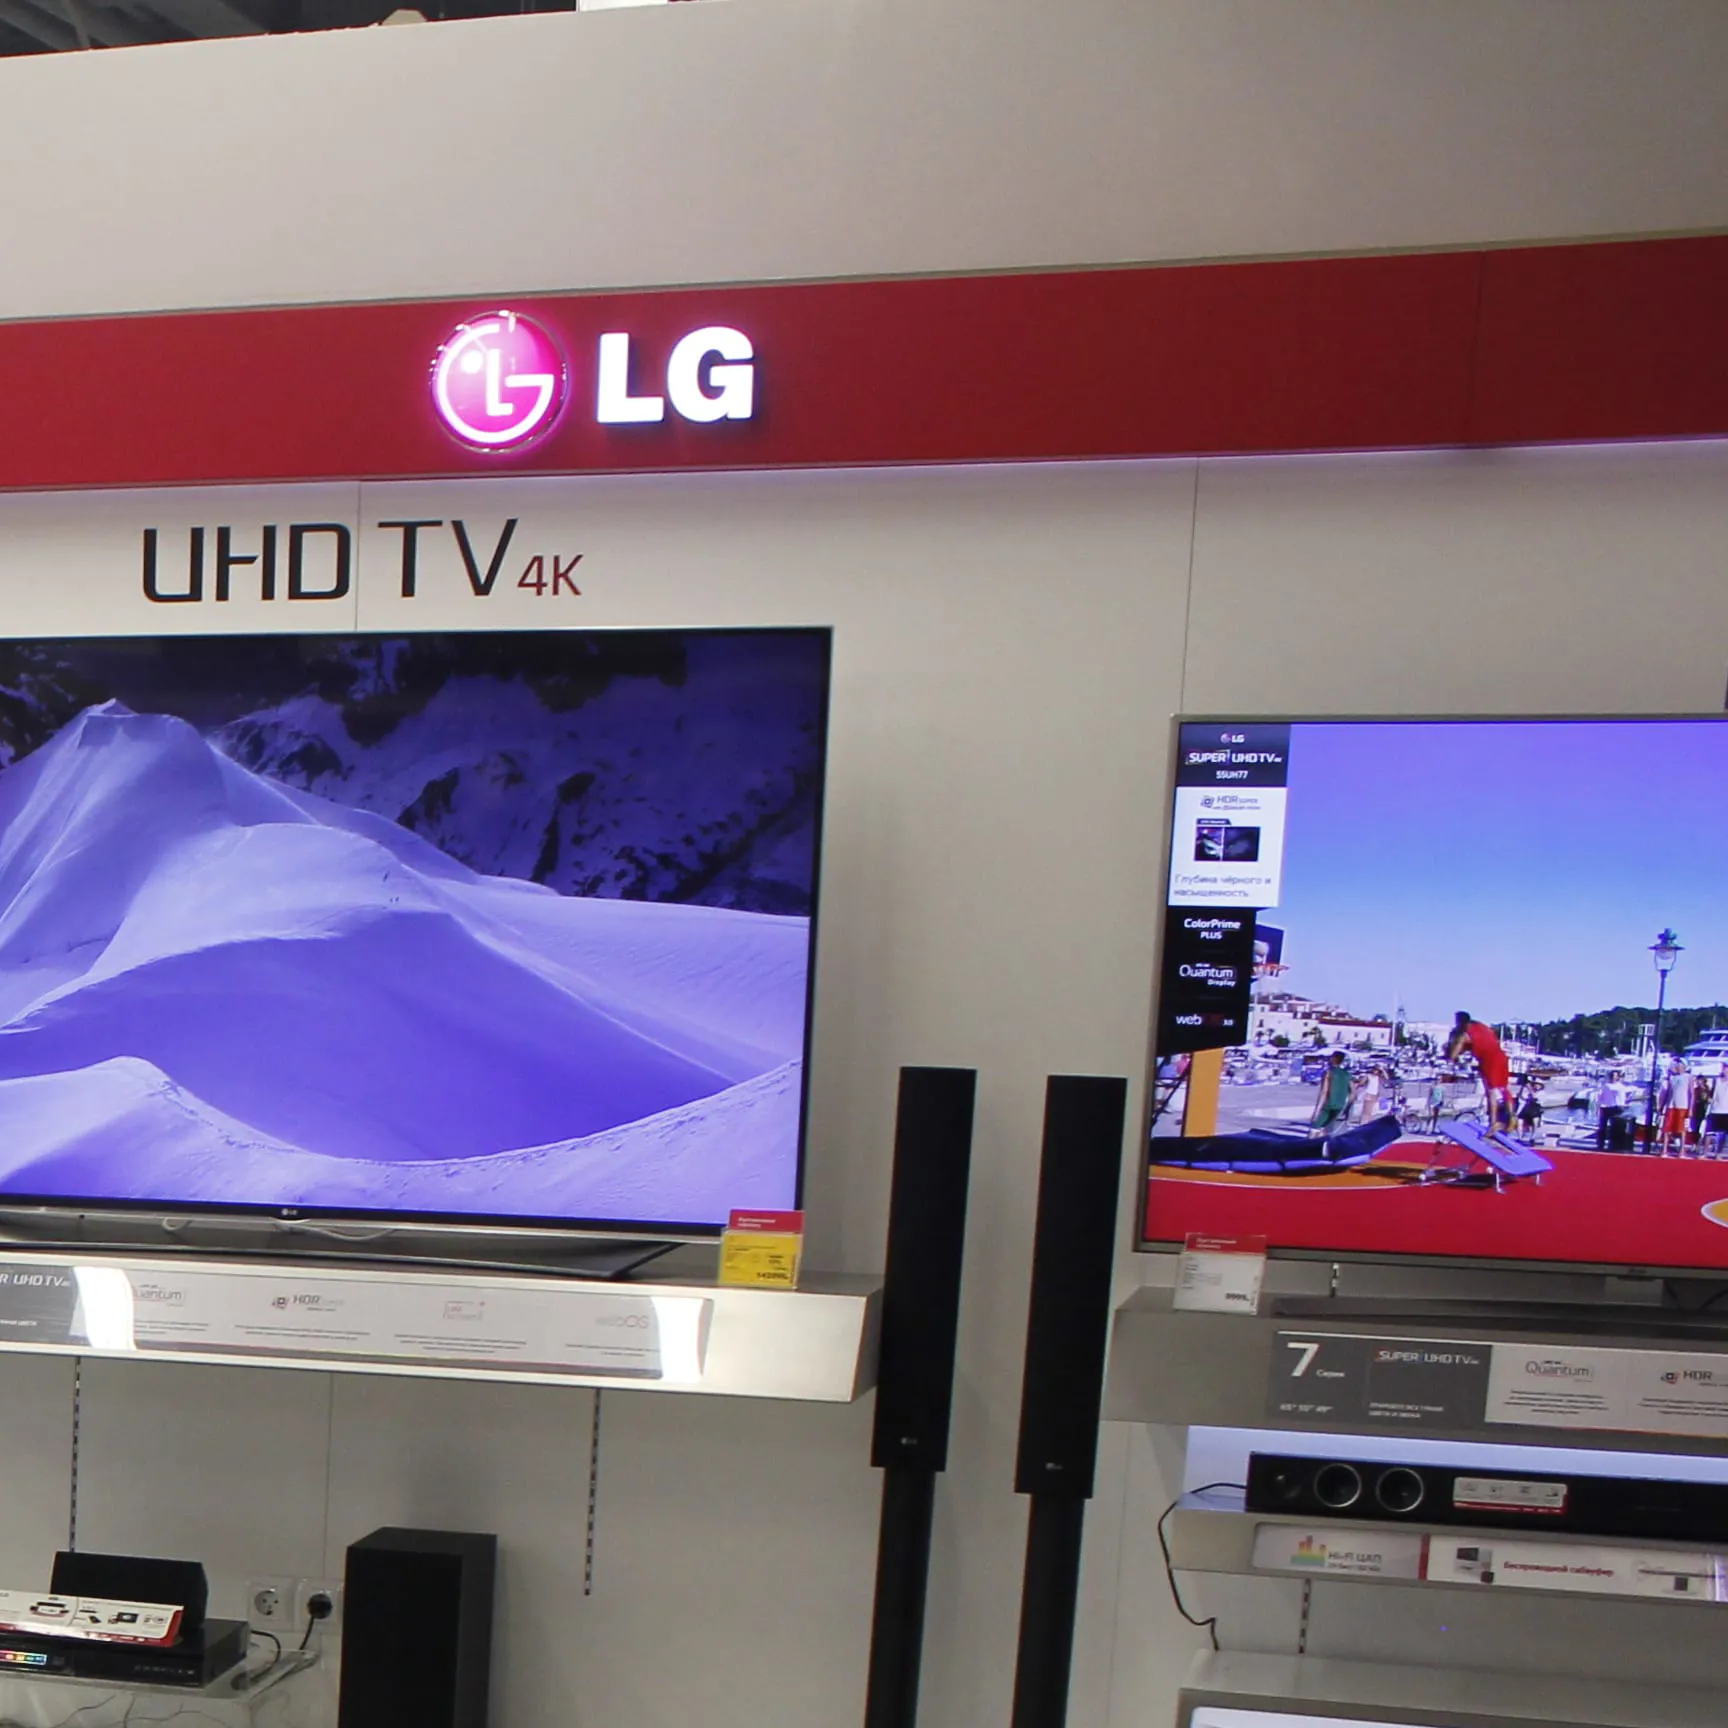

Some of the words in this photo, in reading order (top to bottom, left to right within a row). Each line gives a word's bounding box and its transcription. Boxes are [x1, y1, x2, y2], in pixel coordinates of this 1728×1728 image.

[597, 327, 755, 424] LG
[143, 522, 352, 603] UHD
[1231, 734, 1245, 743] LG
[1188, 752, 1227, 763] SUPER
[1184, 918, 1242, 929] ColorPrime
[1200, 931, 1223, 940] PLUS
[1179, 964, 1234, 977] Quantum
[13, 1274, 43, 1286] UHD
[293, 1294, 321, 1304] HDR
[1287, 1341, 1321, 1377] 7
[1378, 1350, 1419, 1362] SUPER
[1424, 1352, 1452, 1364] UHD
[1525, 1361, 1590, 1377] Quantum
[1682, 1370, 1713, 1381] HDR
